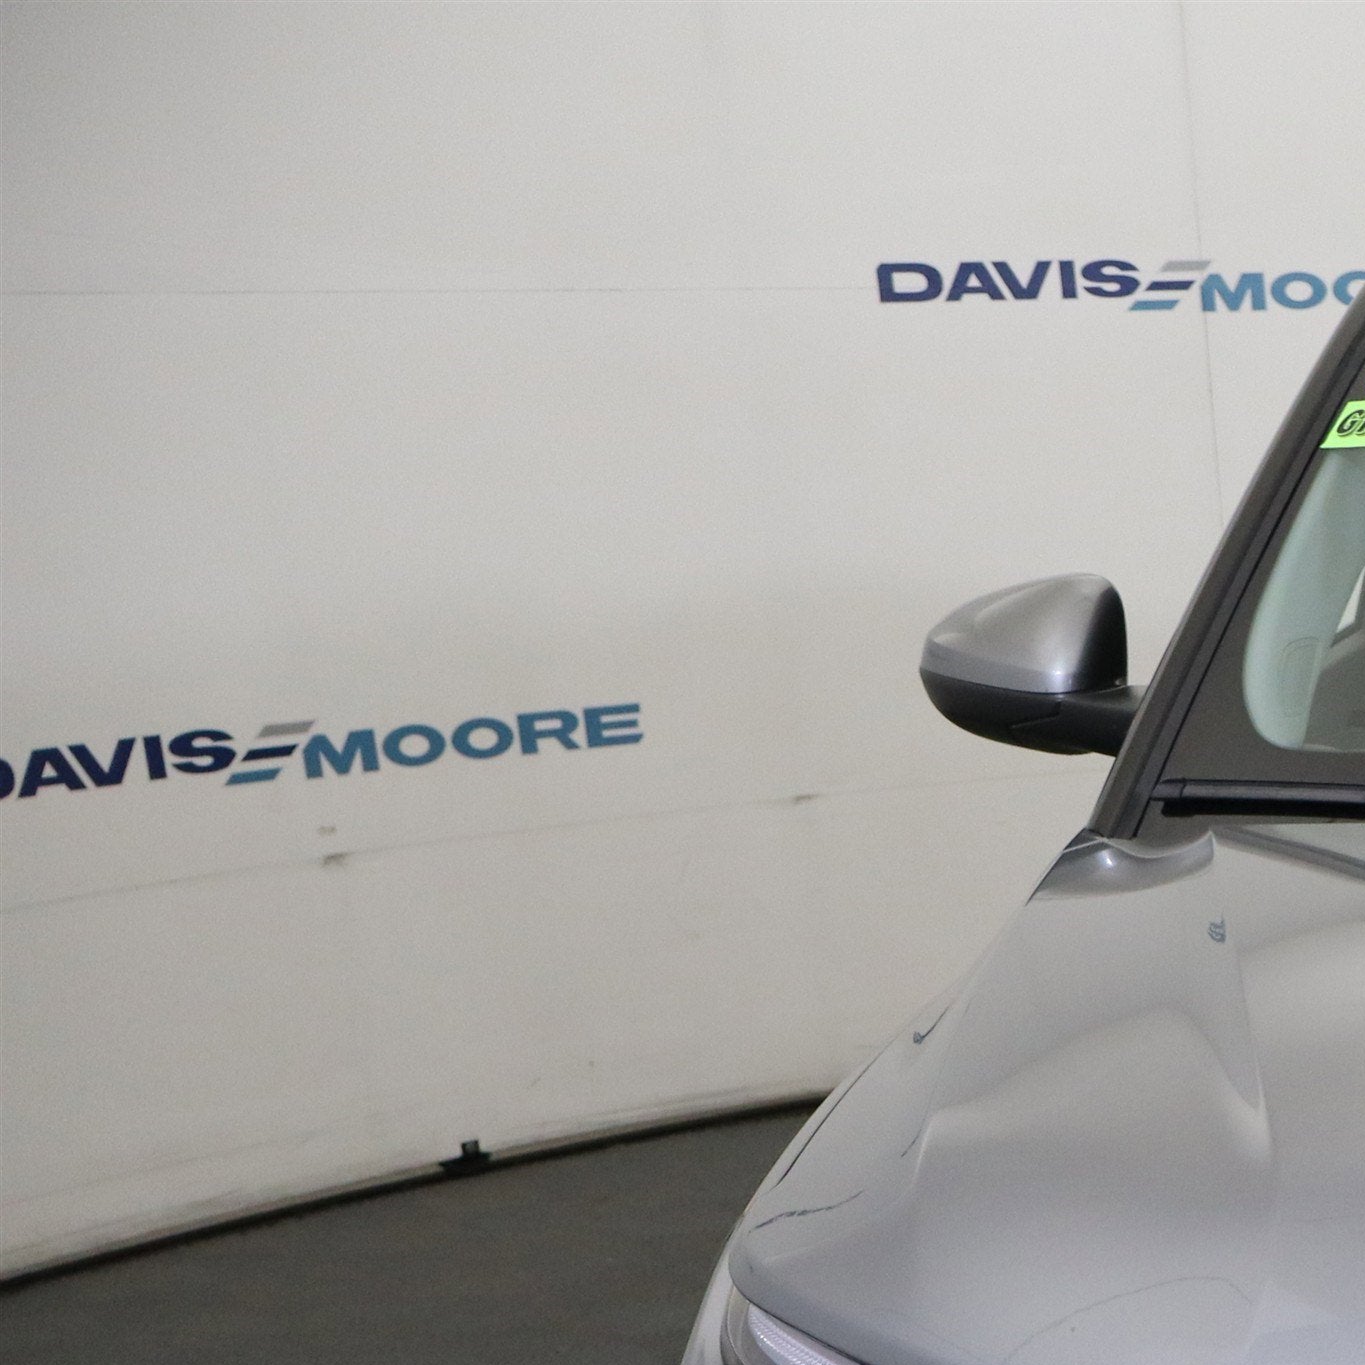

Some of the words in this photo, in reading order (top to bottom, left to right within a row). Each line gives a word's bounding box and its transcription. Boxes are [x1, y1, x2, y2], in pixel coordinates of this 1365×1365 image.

[877, 258, 1140, 302] DAVIS
[0, 729, 237, 800] AVIS
[302, 702, 643, 780] MOORE
